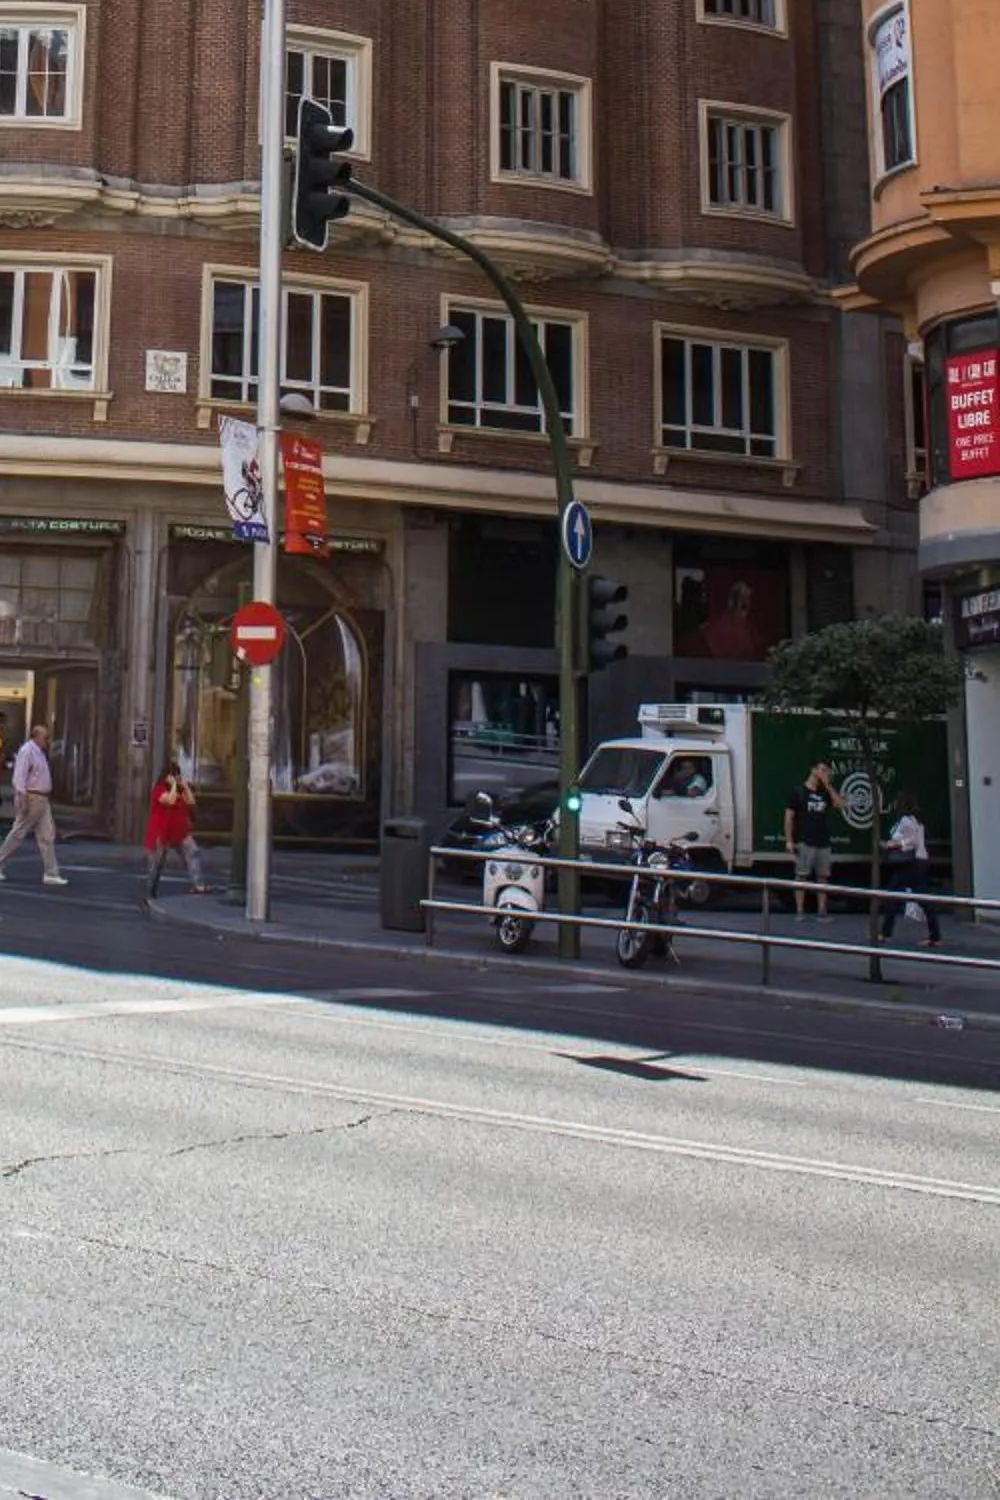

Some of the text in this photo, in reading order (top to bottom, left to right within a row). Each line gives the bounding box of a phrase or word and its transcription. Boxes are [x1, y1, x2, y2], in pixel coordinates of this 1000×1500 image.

[951, 388, 994, 410] BUFFET
[958, 410, 991, 429] LIBRE
[956, 435, 972, 448] ONE
